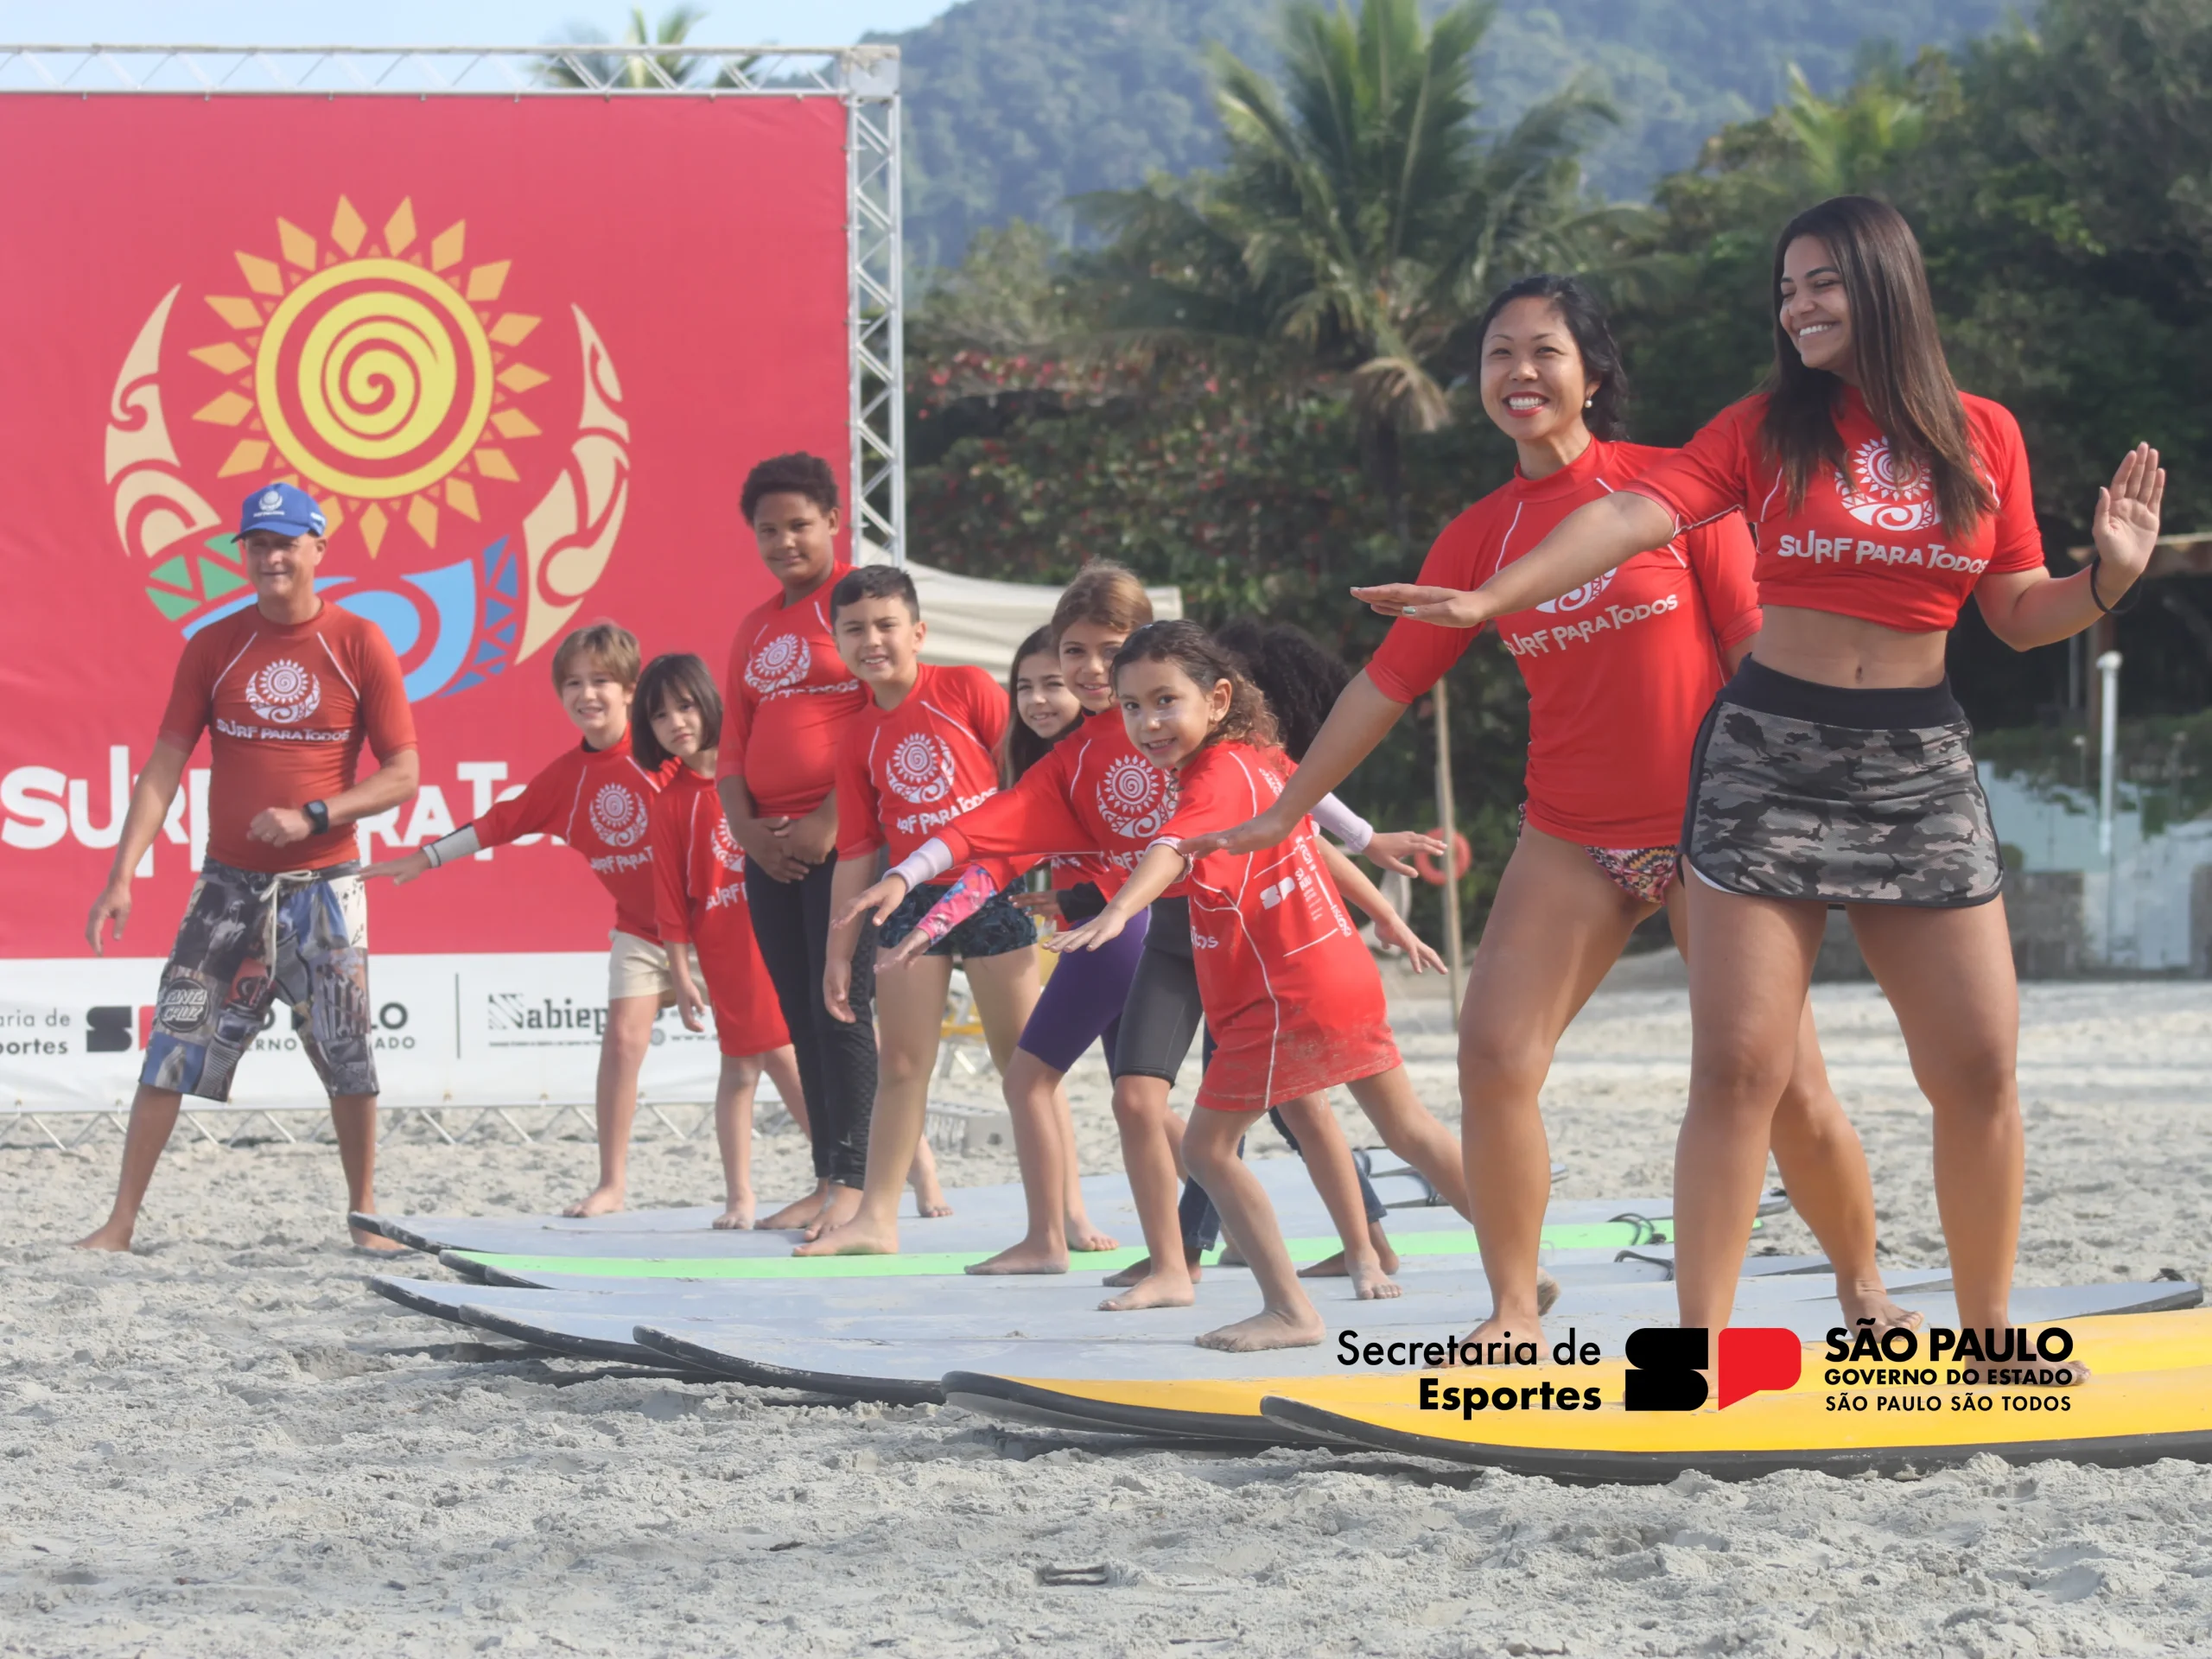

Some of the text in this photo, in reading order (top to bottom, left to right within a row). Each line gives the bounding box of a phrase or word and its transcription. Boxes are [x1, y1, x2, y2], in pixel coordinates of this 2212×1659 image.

[1777, 530, 1989, 575] SURF PARA TODOS
[1503, 594, 1679, 658] SURF PARA TODOS
[217, 718, 351, 741] SURF PARA TODOS
[45, 1007, 71, 1027] de
[162, 1005, 204, 1021] CRUZ
